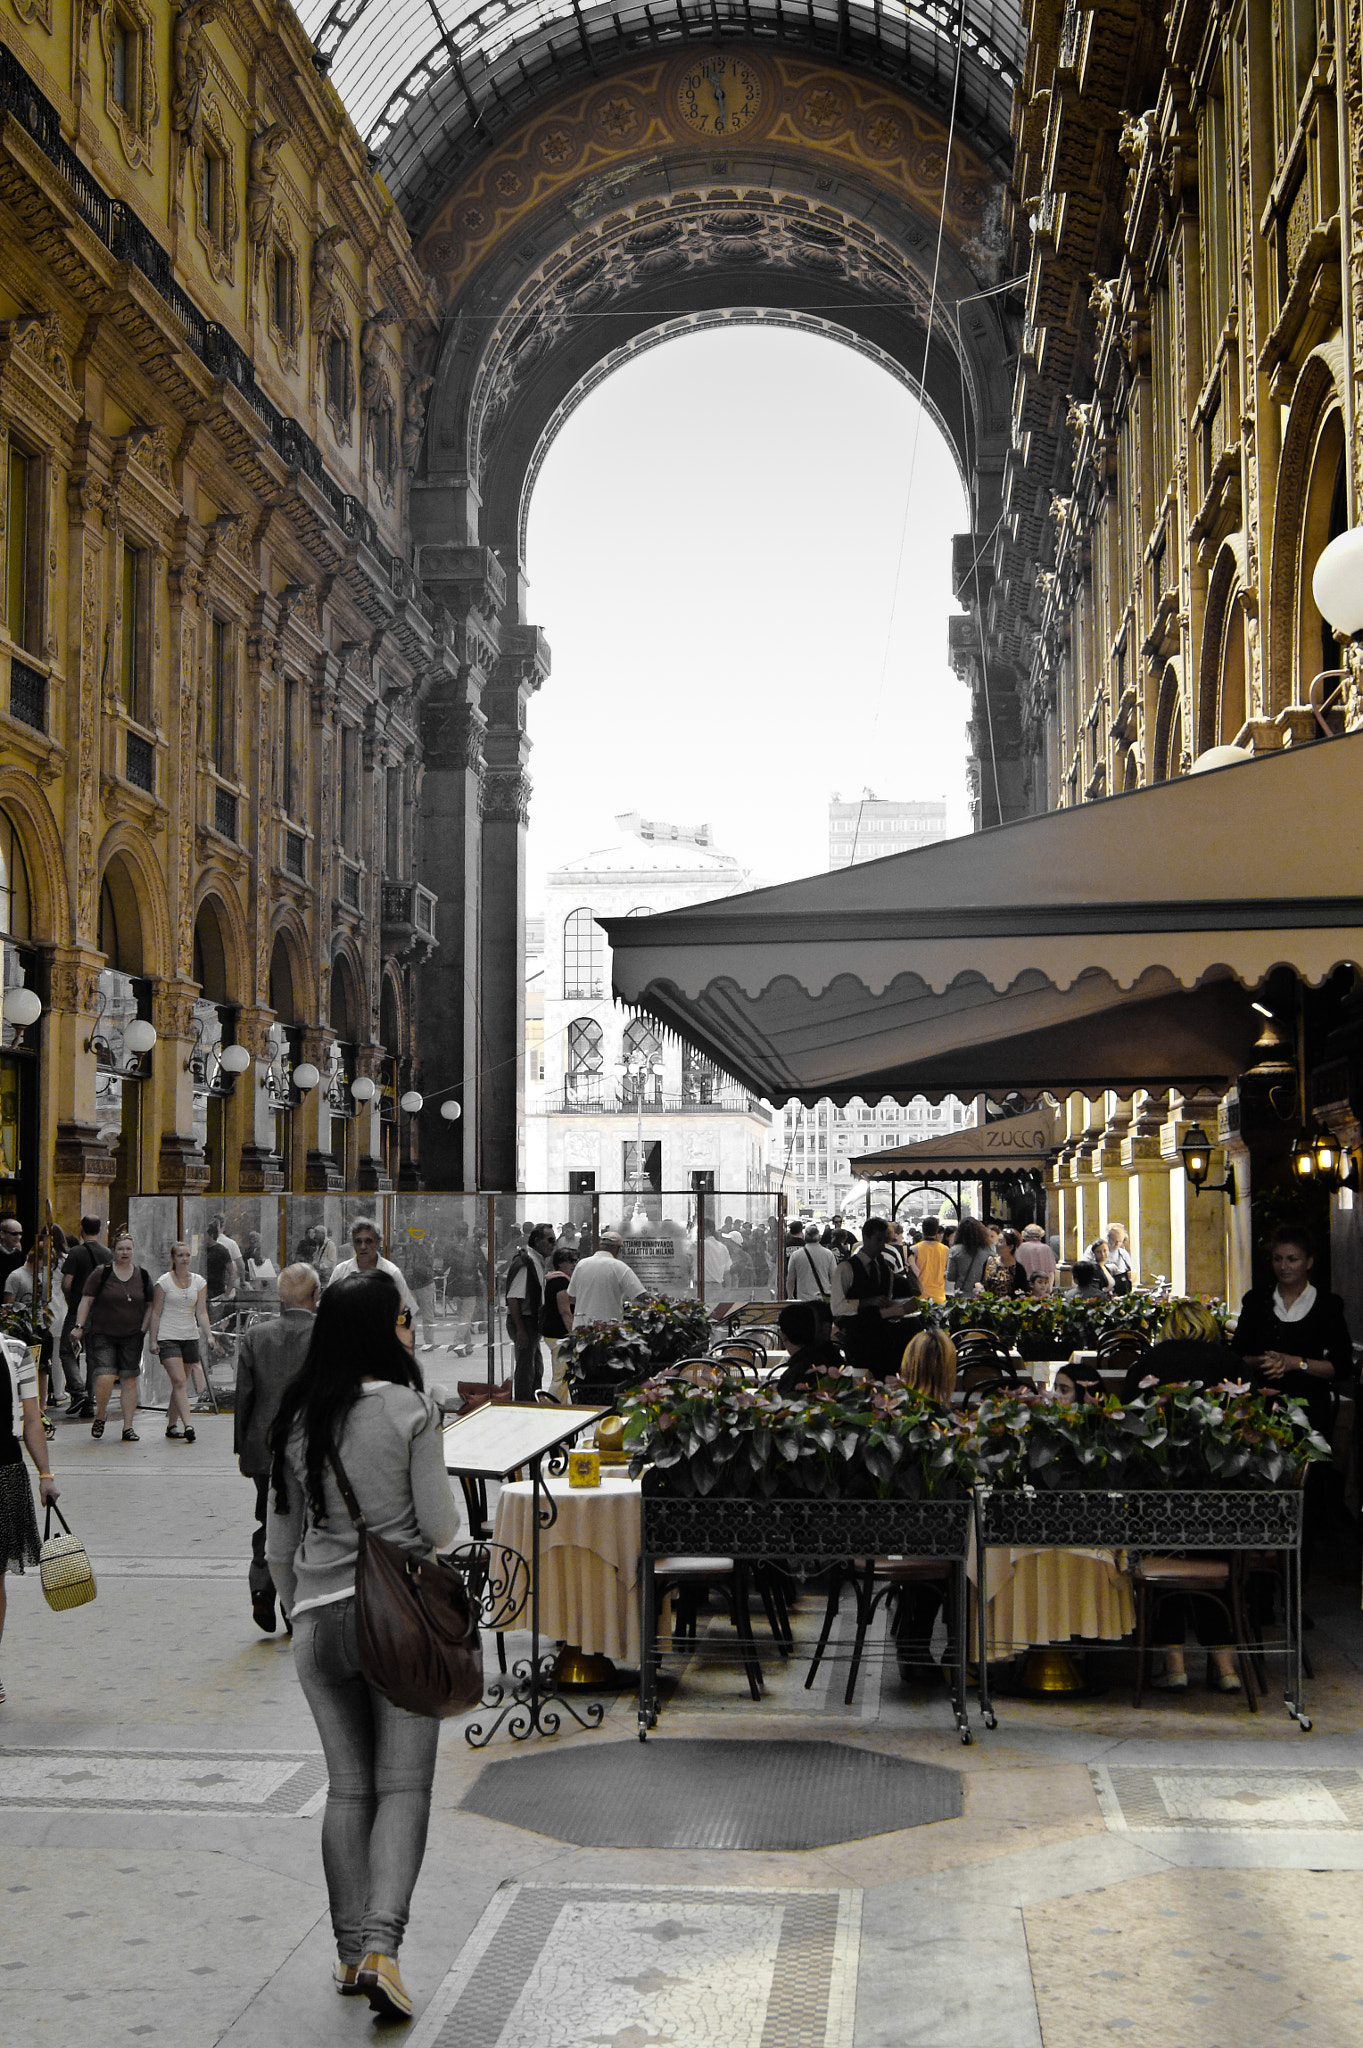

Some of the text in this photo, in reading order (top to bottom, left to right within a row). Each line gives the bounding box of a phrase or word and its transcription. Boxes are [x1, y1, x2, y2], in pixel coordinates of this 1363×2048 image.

[702, 65, 709, 79] 11
[712, 61, 726, 74] 12
[688, 75, 701, 90] 10
[741, 70, 750, 85] 2
[685, 89, 695, 104] 9
[745, 84, 754, 101] 3
[690, 103, 698, 119] 8
[740, 102, 751, 117] 4
[700, 114, 709, 128] 7
[714, 116, 725, 131] 6
[731, 112, 741, 127] 5
[986, 1130, 1046, 1149] ZUCCA
[622, 1240, 674, 1248] STIAMO RINNOVANDO
